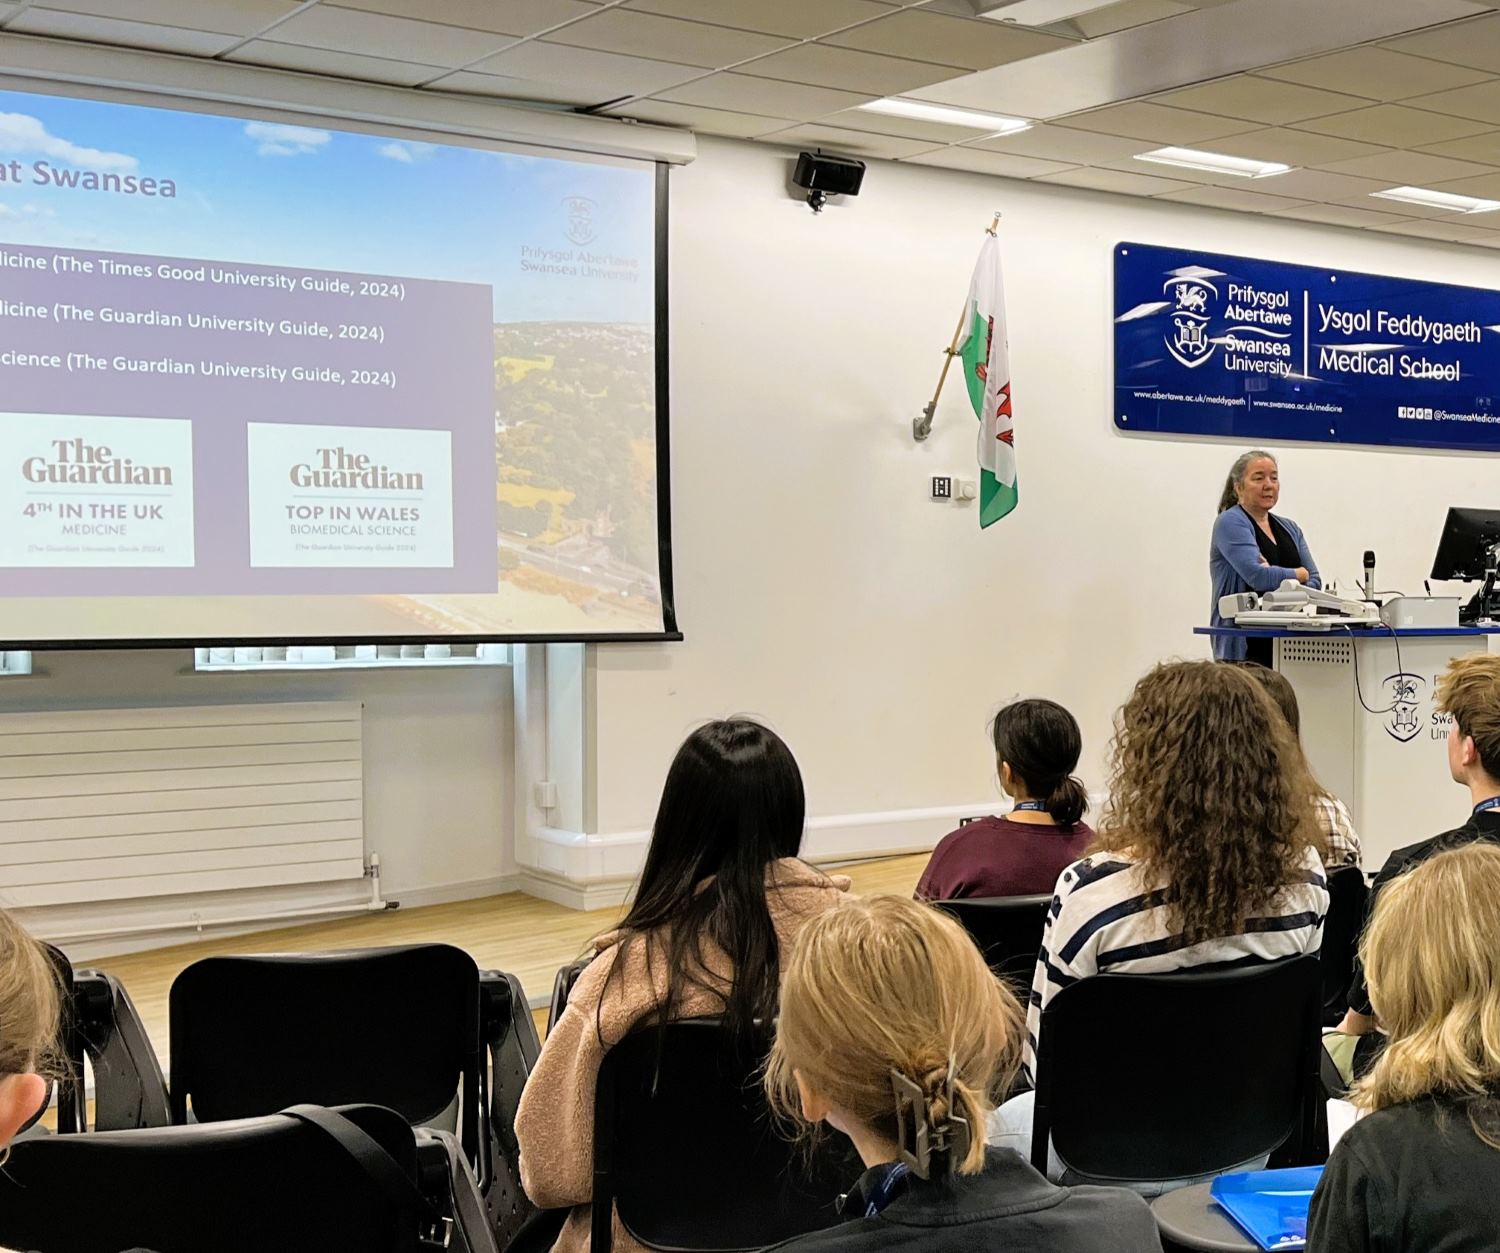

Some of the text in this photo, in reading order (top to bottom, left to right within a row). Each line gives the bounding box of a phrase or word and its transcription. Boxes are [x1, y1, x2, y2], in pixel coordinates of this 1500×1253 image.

[33, 160, 176, 198] Swansea
[53, 254, 94, 274] (The
[98, 259, 152, 278] Times
[157, 264, 205, 282] Good
[211, 268, 296, 292] University
[301, 276, 355, 297] Guide,
[360, 281, 405, 301] 2024)
[520, 259, 576, 276] Swansea
[1228, 284, 1289, 310] Prifysgol
[53, 303, 94, 323] (The
[99, 307, 182, 327] Guardian
[188, 313, 274, 336] University
[279, 320, 334, 340] Guide,
[339, 324, 385, 344] 2024)
[1224, 304, 1292, 326] Abertawe
[1318, 303, 1481, 344] Ysgol Feddygaeth
[1225, 334, 1291, 357] Swansea
[67, 352, 107, 372] (The
[113, 356, 195, 375] Guardian
[201, 361, 286, 382] University
[291, 366, 346, 385] Guide,
[350, 370, 396, 389] 2024)
[1224, 354, 1292, 378] University
[1319, 347, 1460, 381] Medical School
[1133, 390, 1343, 413] www.abertawe.ac.uk/meddygaeth www.swansea.ac.uk/medicine
[51, 438, 112, 464] The
[316, 446, 370, 471] The
[22, 456, 173, 486] Guardian
[289, 463, 424, 490] Guardian
[23, 502, 163, 520] 4TH IN THE UK
[285, 505, 420, 521] TOP IN WALES
[61, 523, 127, 536] MEDICINE
[290, 524, 417, 536] BIOMEDICAL SCIENCE
